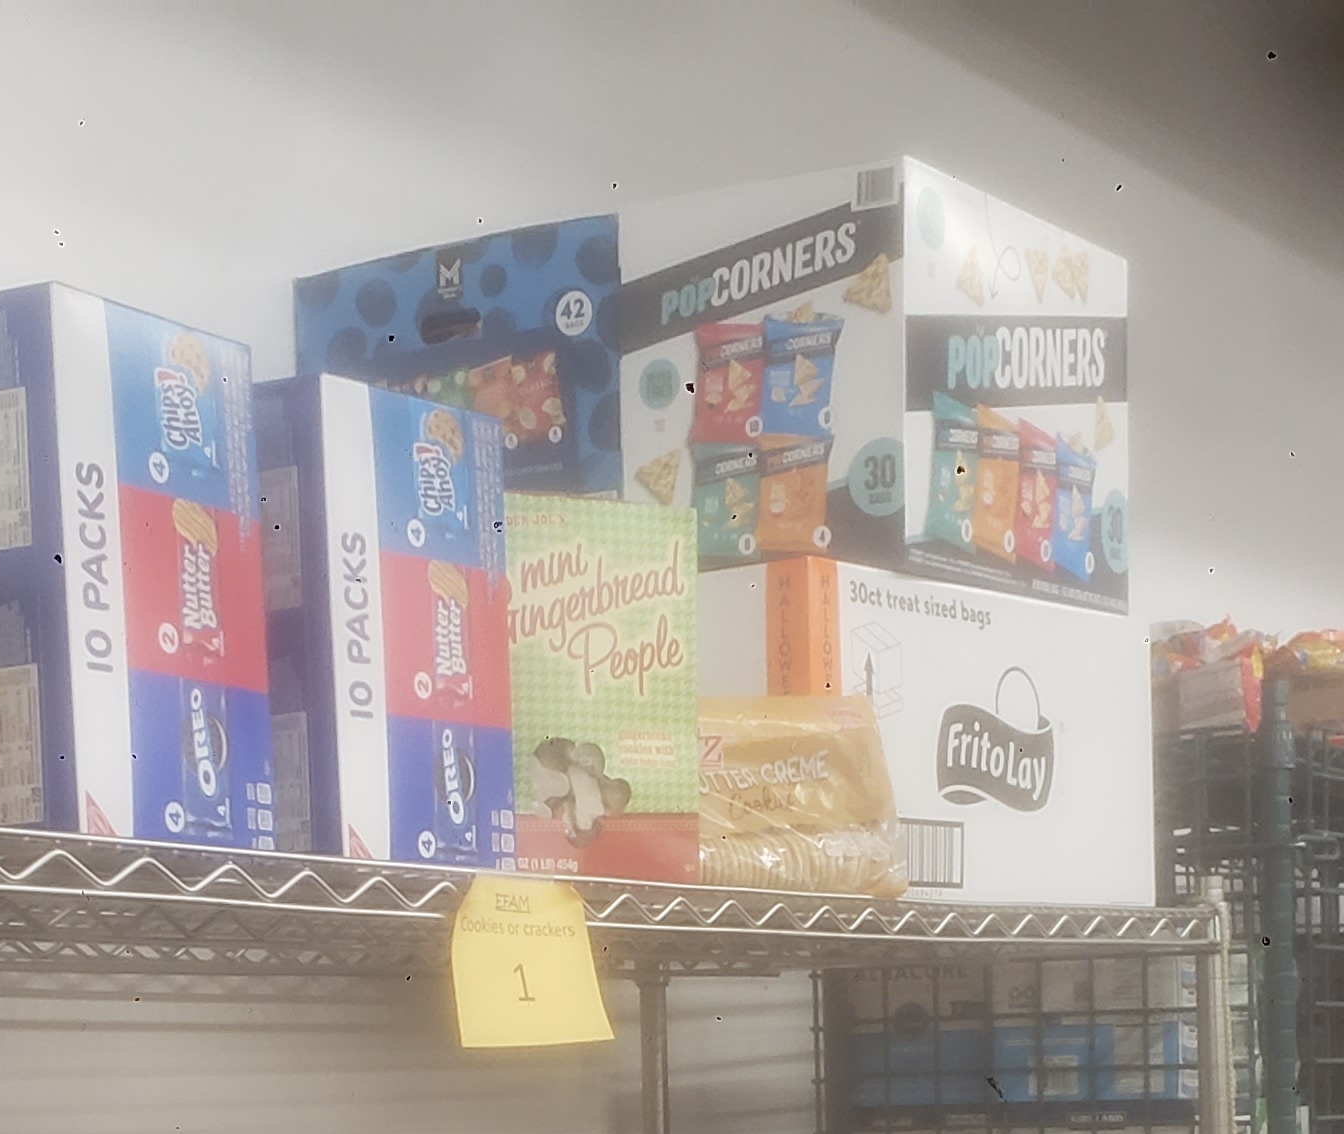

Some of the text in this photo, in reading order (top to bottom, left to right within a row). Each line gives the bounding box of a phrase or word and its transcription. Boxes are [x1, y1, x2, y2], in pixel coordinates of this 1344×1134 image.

[561, 299, 585, 319] 42
[661, 222, 856, 326] POPCORNERS
[947, 327, 1107, 390] POPCORNERS
[863, 454, 897, 491] 30
[75, 461, 108, 613] PACKS
[521, 543, 589, 594] mini
[182, 543, 219, 629] Nutter Butter
[341, 531, 373, 666] PACKS
[849, 580, 992, 630] 30ct treat sized bags
[435, 598, 468, 676] Nutter Butter
[567, 613, 684, 697] People
[777, 576, 792, 694] HALLOWE
[190, 687, 217, 798] OREO
[442, 728, 465, 825] OREO
[699, 750, 830, 795] UTTER CREME
[557, 859, 579, 873] 454g
[460, 916, 576, 938] Cookies or crackers
[513, 962, 536, 1003] 1
